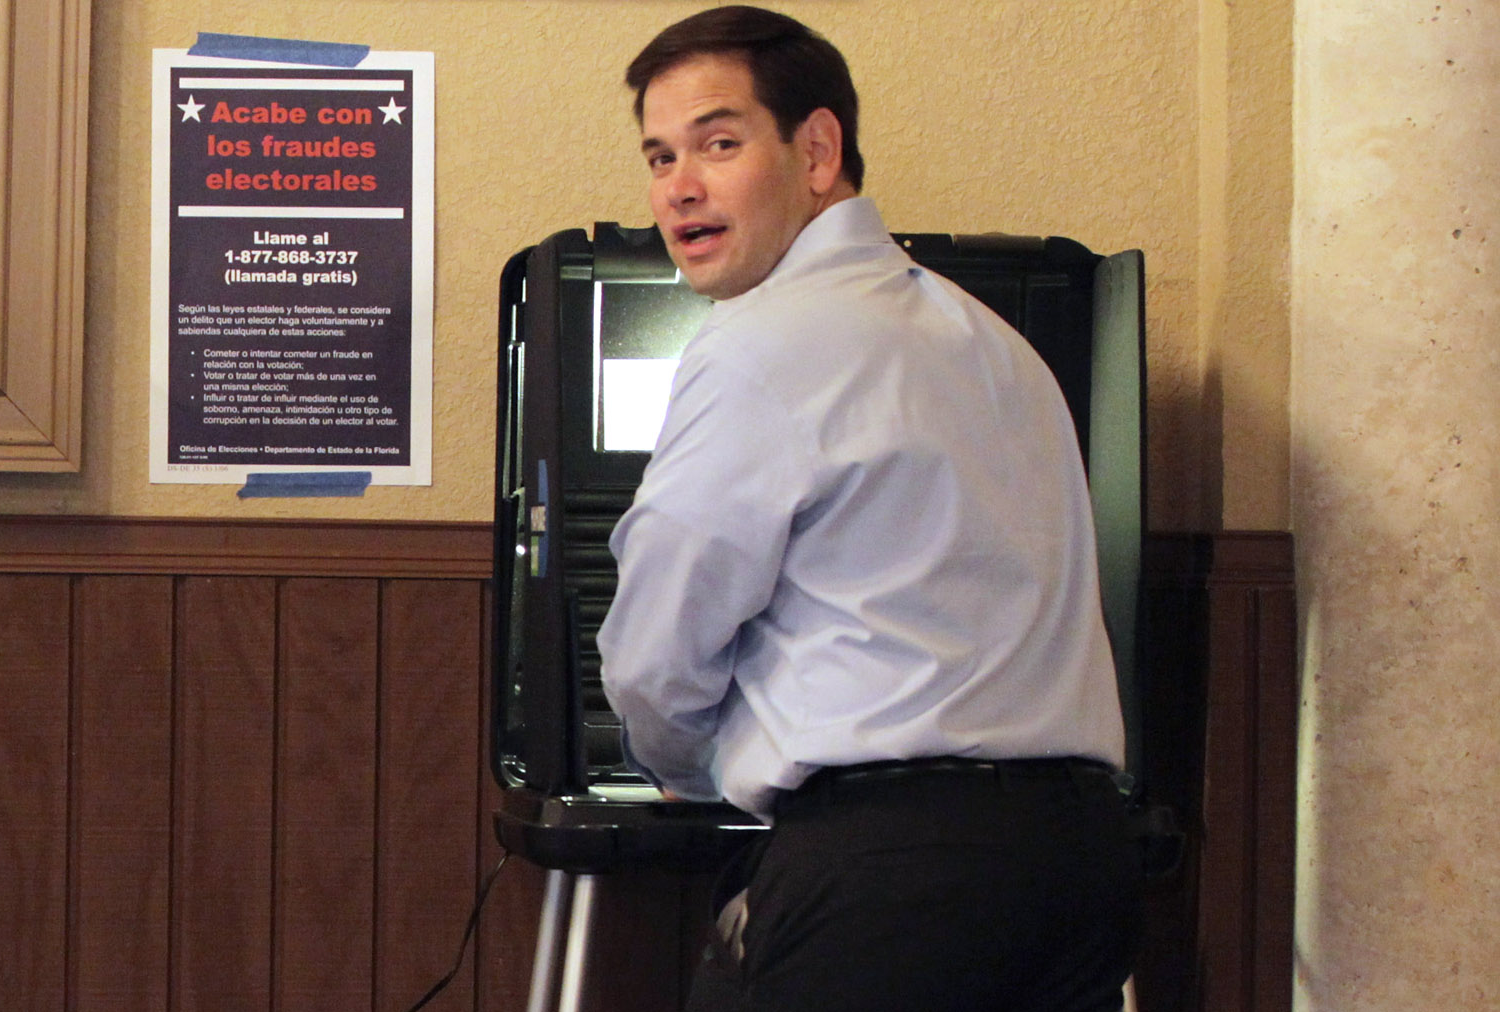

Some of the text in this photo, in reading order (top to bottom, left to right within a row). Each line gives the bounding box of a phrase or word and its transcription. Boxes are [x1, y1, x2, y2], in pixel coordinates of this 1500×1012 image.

[211, 101, 372, 125] Acabe con
[207, 134, 377, 158] los fraudes
[205, 168, 377, 191] electorales
[253, 231, 329, 245] Llame al
[224, 250, 358, 264] 1-877-868-3737
[224, 269, 358, 286] (llamada gratis)
[208, 304, 220, 313] las
[222, 304, 245, 315] leyes
[247, 305, 284, 314] estatales
[287, 307, 292, 316] y
[350, 306, 390, 315] considera
[191, 315, 214, 324] delito
[216, 317, 232, 326] que
[248, 315, 276, 324] elector
[278, 316, 300, 326] haga
[302, 316, 368, 325] voluntariamente
[370, 319, 375, 327] y
[178, 326, 221, 335] sabiendas
[223, 327, 266, 338] cualquiera
[268, 327, 280, 336] de
[282, 327, 304, 336] estas
[204, 349, 240, 358] Cometer
[250, 349, 281, 358] intentar
[283, 349, 317, 358] cometer
[333, 350, 360, 358] fraude
[256, 360, 264, 369] la
[204, 371, 226, 380] Votar
[236, 371, 258, 380] tratar
[260, 372, 271, 380] de
[273, 372, 294, 380] votar
[316, 372, 327, 380] de
[222, 382, 250, 391] misma
[204, 393, 227, 402] Influir
[236, 393, 259, 402] tratar
[261, 393, 272, 402] de
[274, 394, 297, 402] influir
[299, 394, 338, 402] mediante
[340, 394, 348, 403] el
[368, 394, 378, 403] de
[345, 405, 362, 414] otro
[364, 406, 379, 416] tipo
[381, 406, 392, 414] de
[262, 415, 270, 424] la
[309, 416, 320, 424] de
[335, 416, 363, 425] elector
[366, 416, 374, 425] al
[264, 445, 315, 455] Departamento
